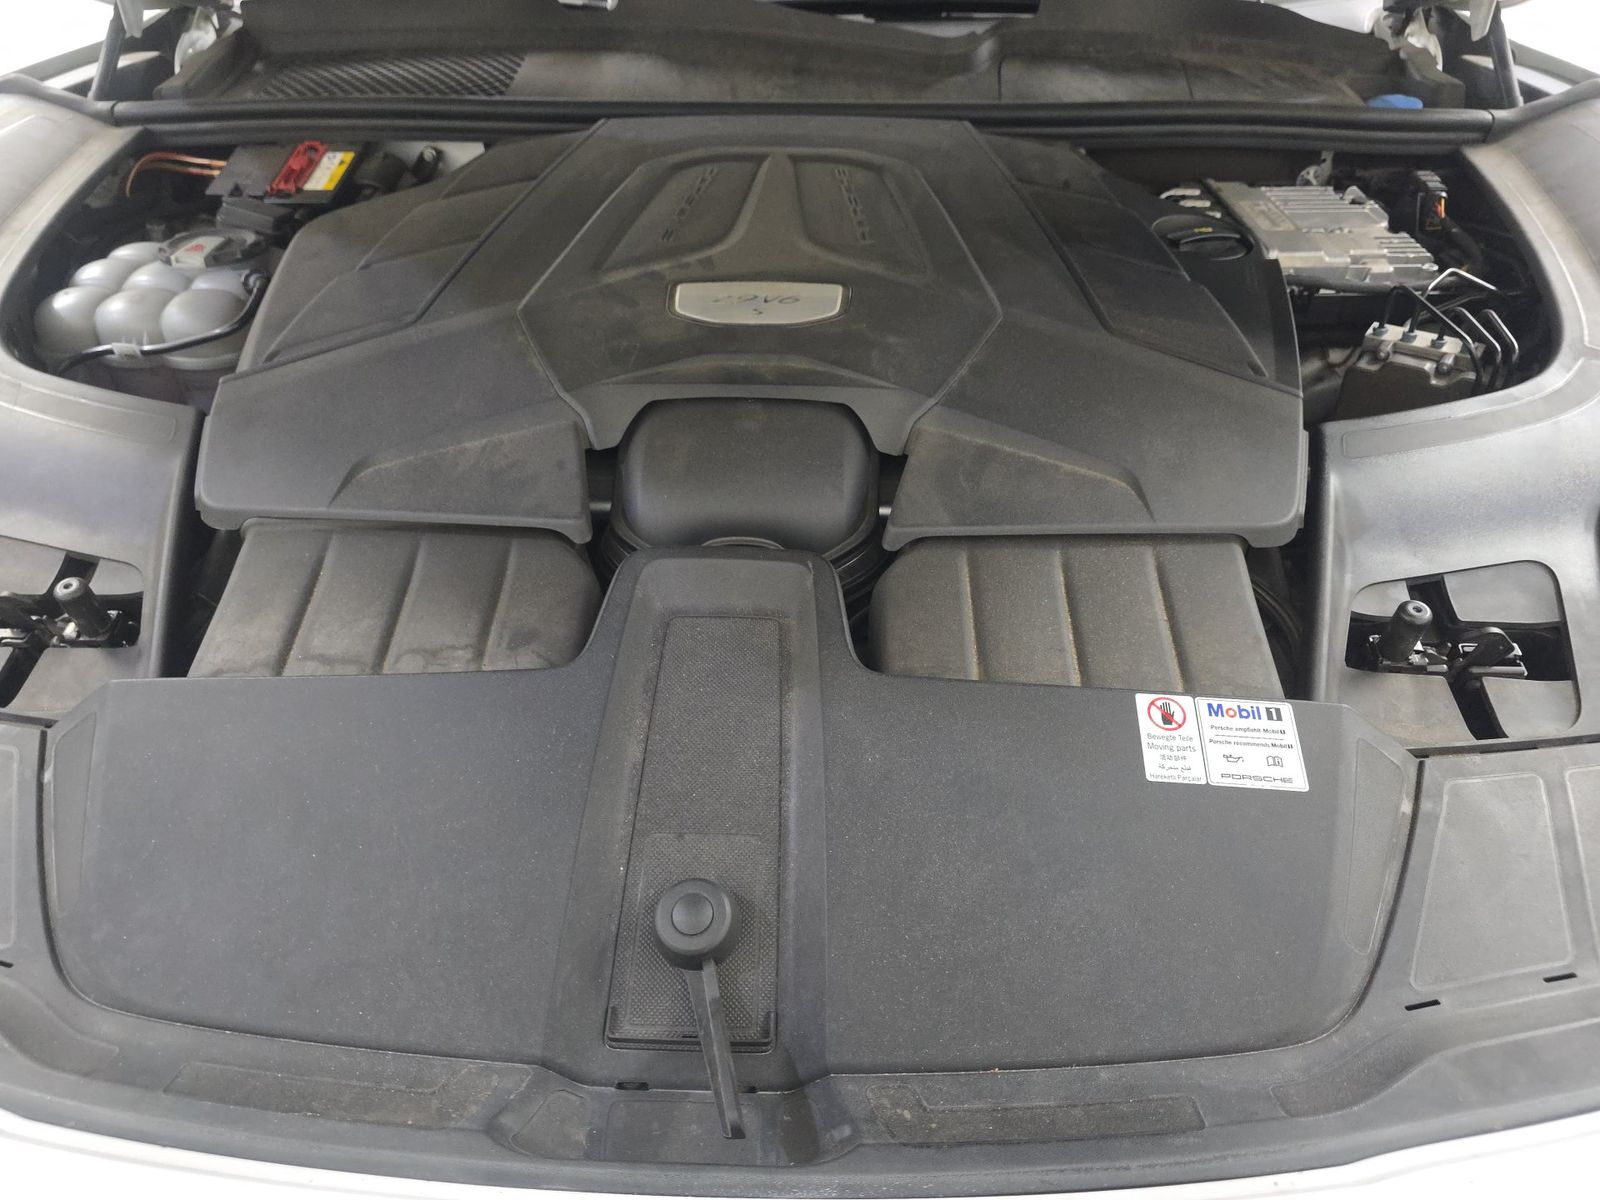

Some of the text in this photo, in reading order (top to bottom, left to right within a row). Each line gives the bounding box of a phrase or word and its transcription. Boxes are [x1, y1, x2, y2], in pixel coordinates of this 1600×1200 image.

[1207, 702, 1283, 722] Mobil 1
[1210, 724, 1234, 732] Porsche
[1147, 732, 1194, 743] Bewegte Teile
[1209, 738, 1233, 746] Porsche
[1233, 740, 1270, 748] recommends
[1147, 742, 1197, 753] Moving parts
[1220, 772, 1294, 784] PORSCHE
